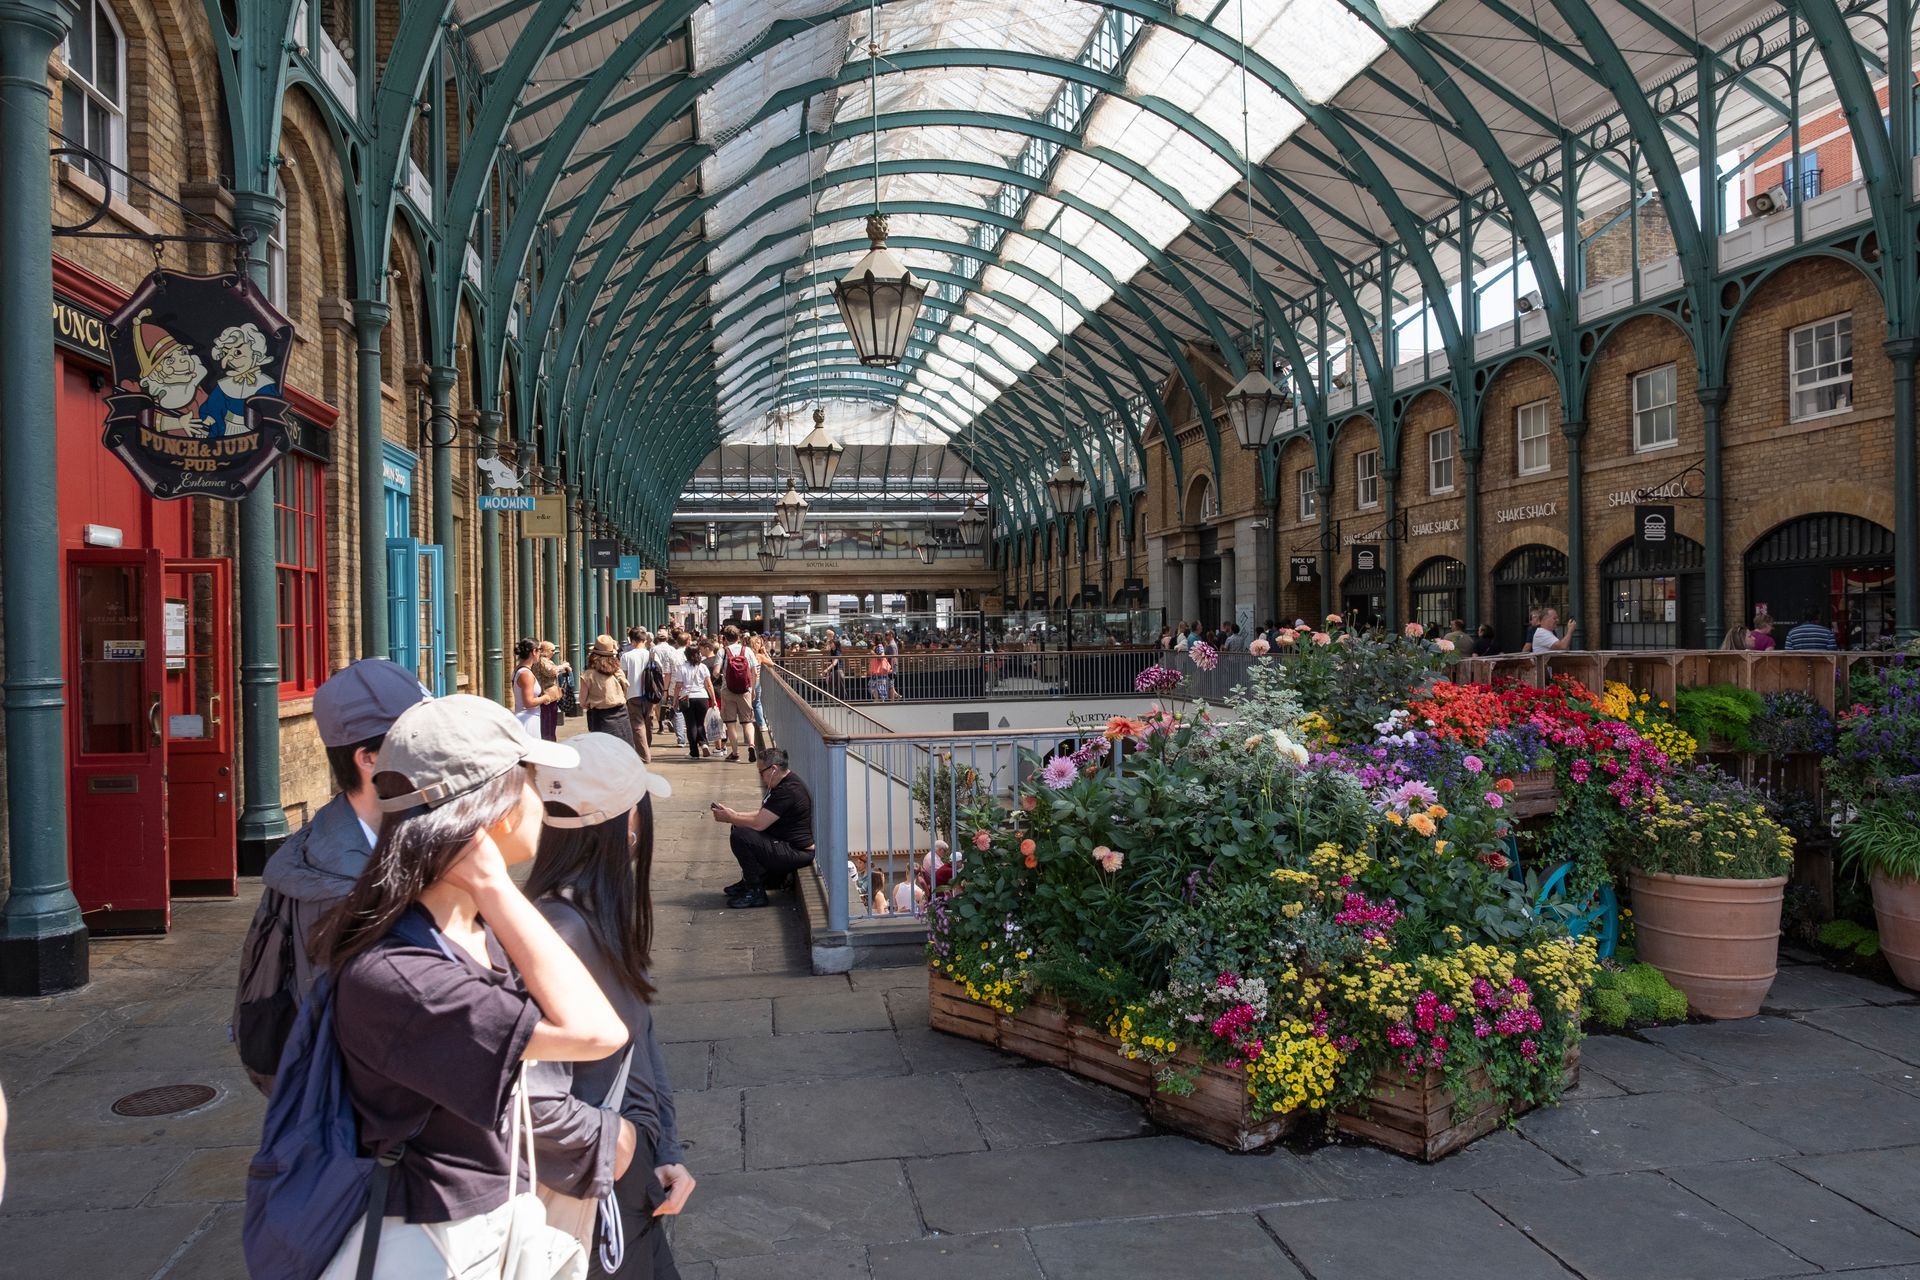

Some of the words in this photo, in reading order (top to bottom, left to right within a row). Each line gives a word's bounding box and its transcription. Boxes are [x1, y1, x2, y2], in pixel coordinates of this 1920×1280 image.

[140, 427, 200, 457] PUNCH
[200, 444, 211, 457] &
[212, 433, 259, 456] JUDY
[183, 459, 217, 471] PUB
[181, 472, 227, 488] Entrance
[484, 497, 529, 509] MOOMIN
[1497, 506, 1526, 523] SHAKE
[1526, 502, 1557, 519] SHACK
[1412, 522, 1435, 537] SHAKE
[1435, 518, 1459, 533] SHACK
